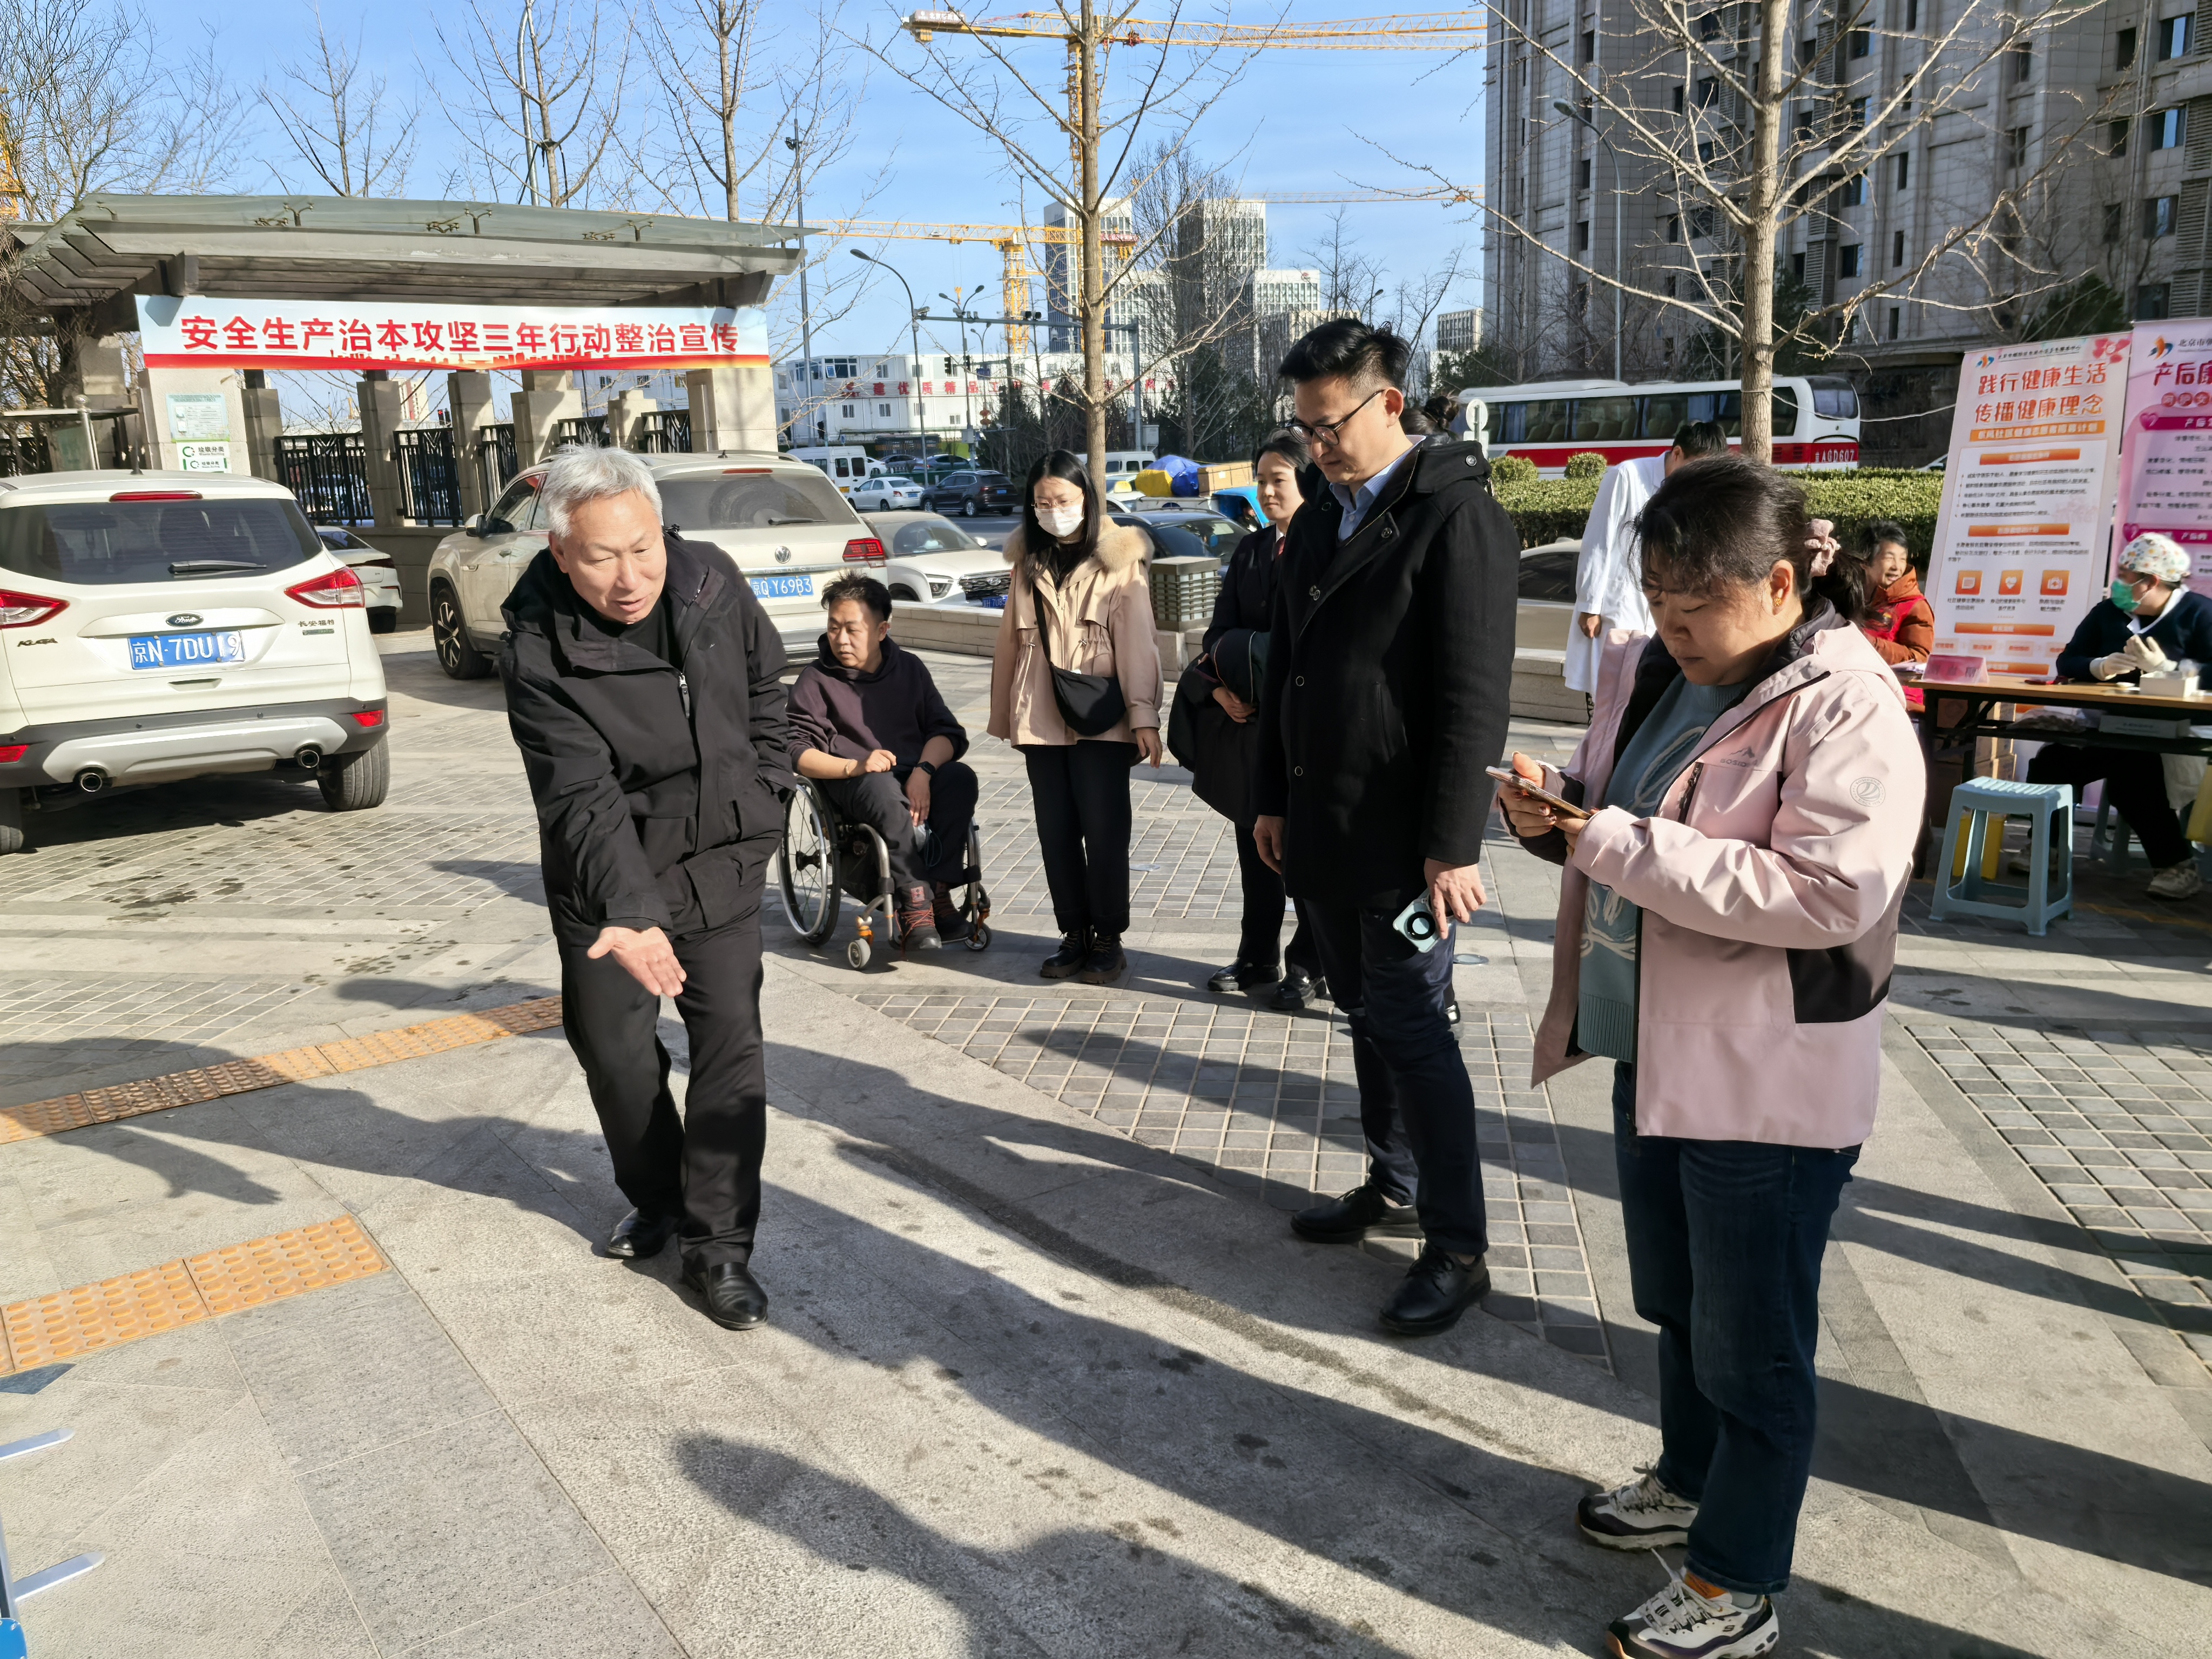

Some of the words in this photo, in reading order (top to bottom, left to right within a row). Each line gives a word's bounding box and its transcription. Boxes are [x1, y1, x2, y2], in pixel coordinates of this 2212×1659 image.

[180, 315, 739, 354] 安全生产治本攻坚三年行动整治宣传
[1978, 362, 2107, 395] 践行健康生活
[1975, 394, 2103, 423] 传播健康理念
[132, 635, 242, 664] 京N·7DU19
